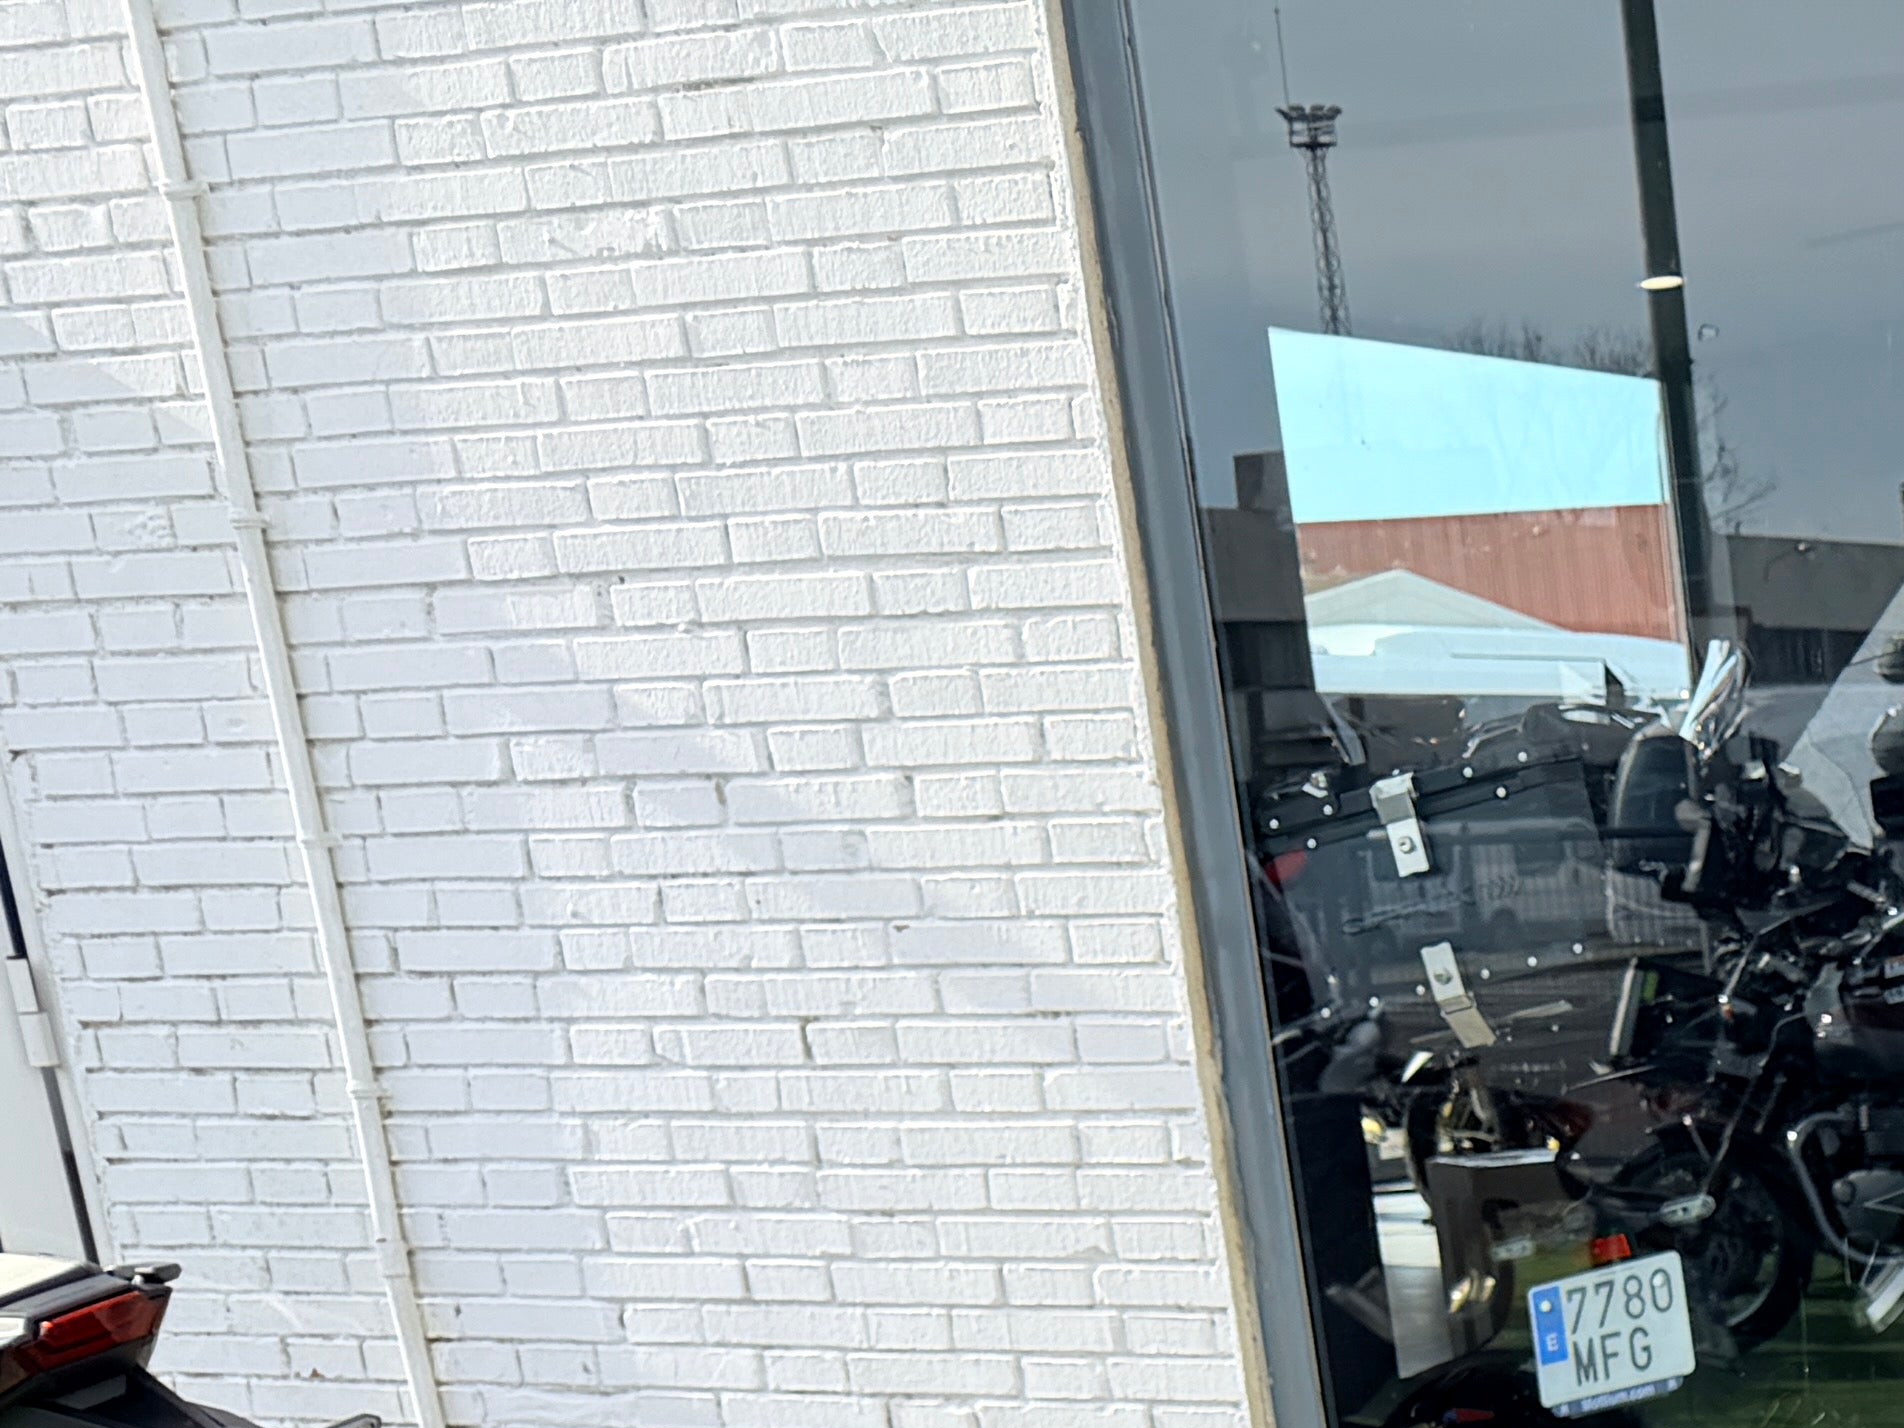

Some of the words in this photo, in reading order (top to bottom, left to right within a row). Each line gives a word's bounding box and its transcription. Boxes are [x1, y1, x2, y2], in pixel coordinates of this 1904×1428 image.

[1566, 1268, 1674, 1335] 7780
[1546, 1331, 1560, 1353] E
[1572, 1327, 1653, 1387] MFG
